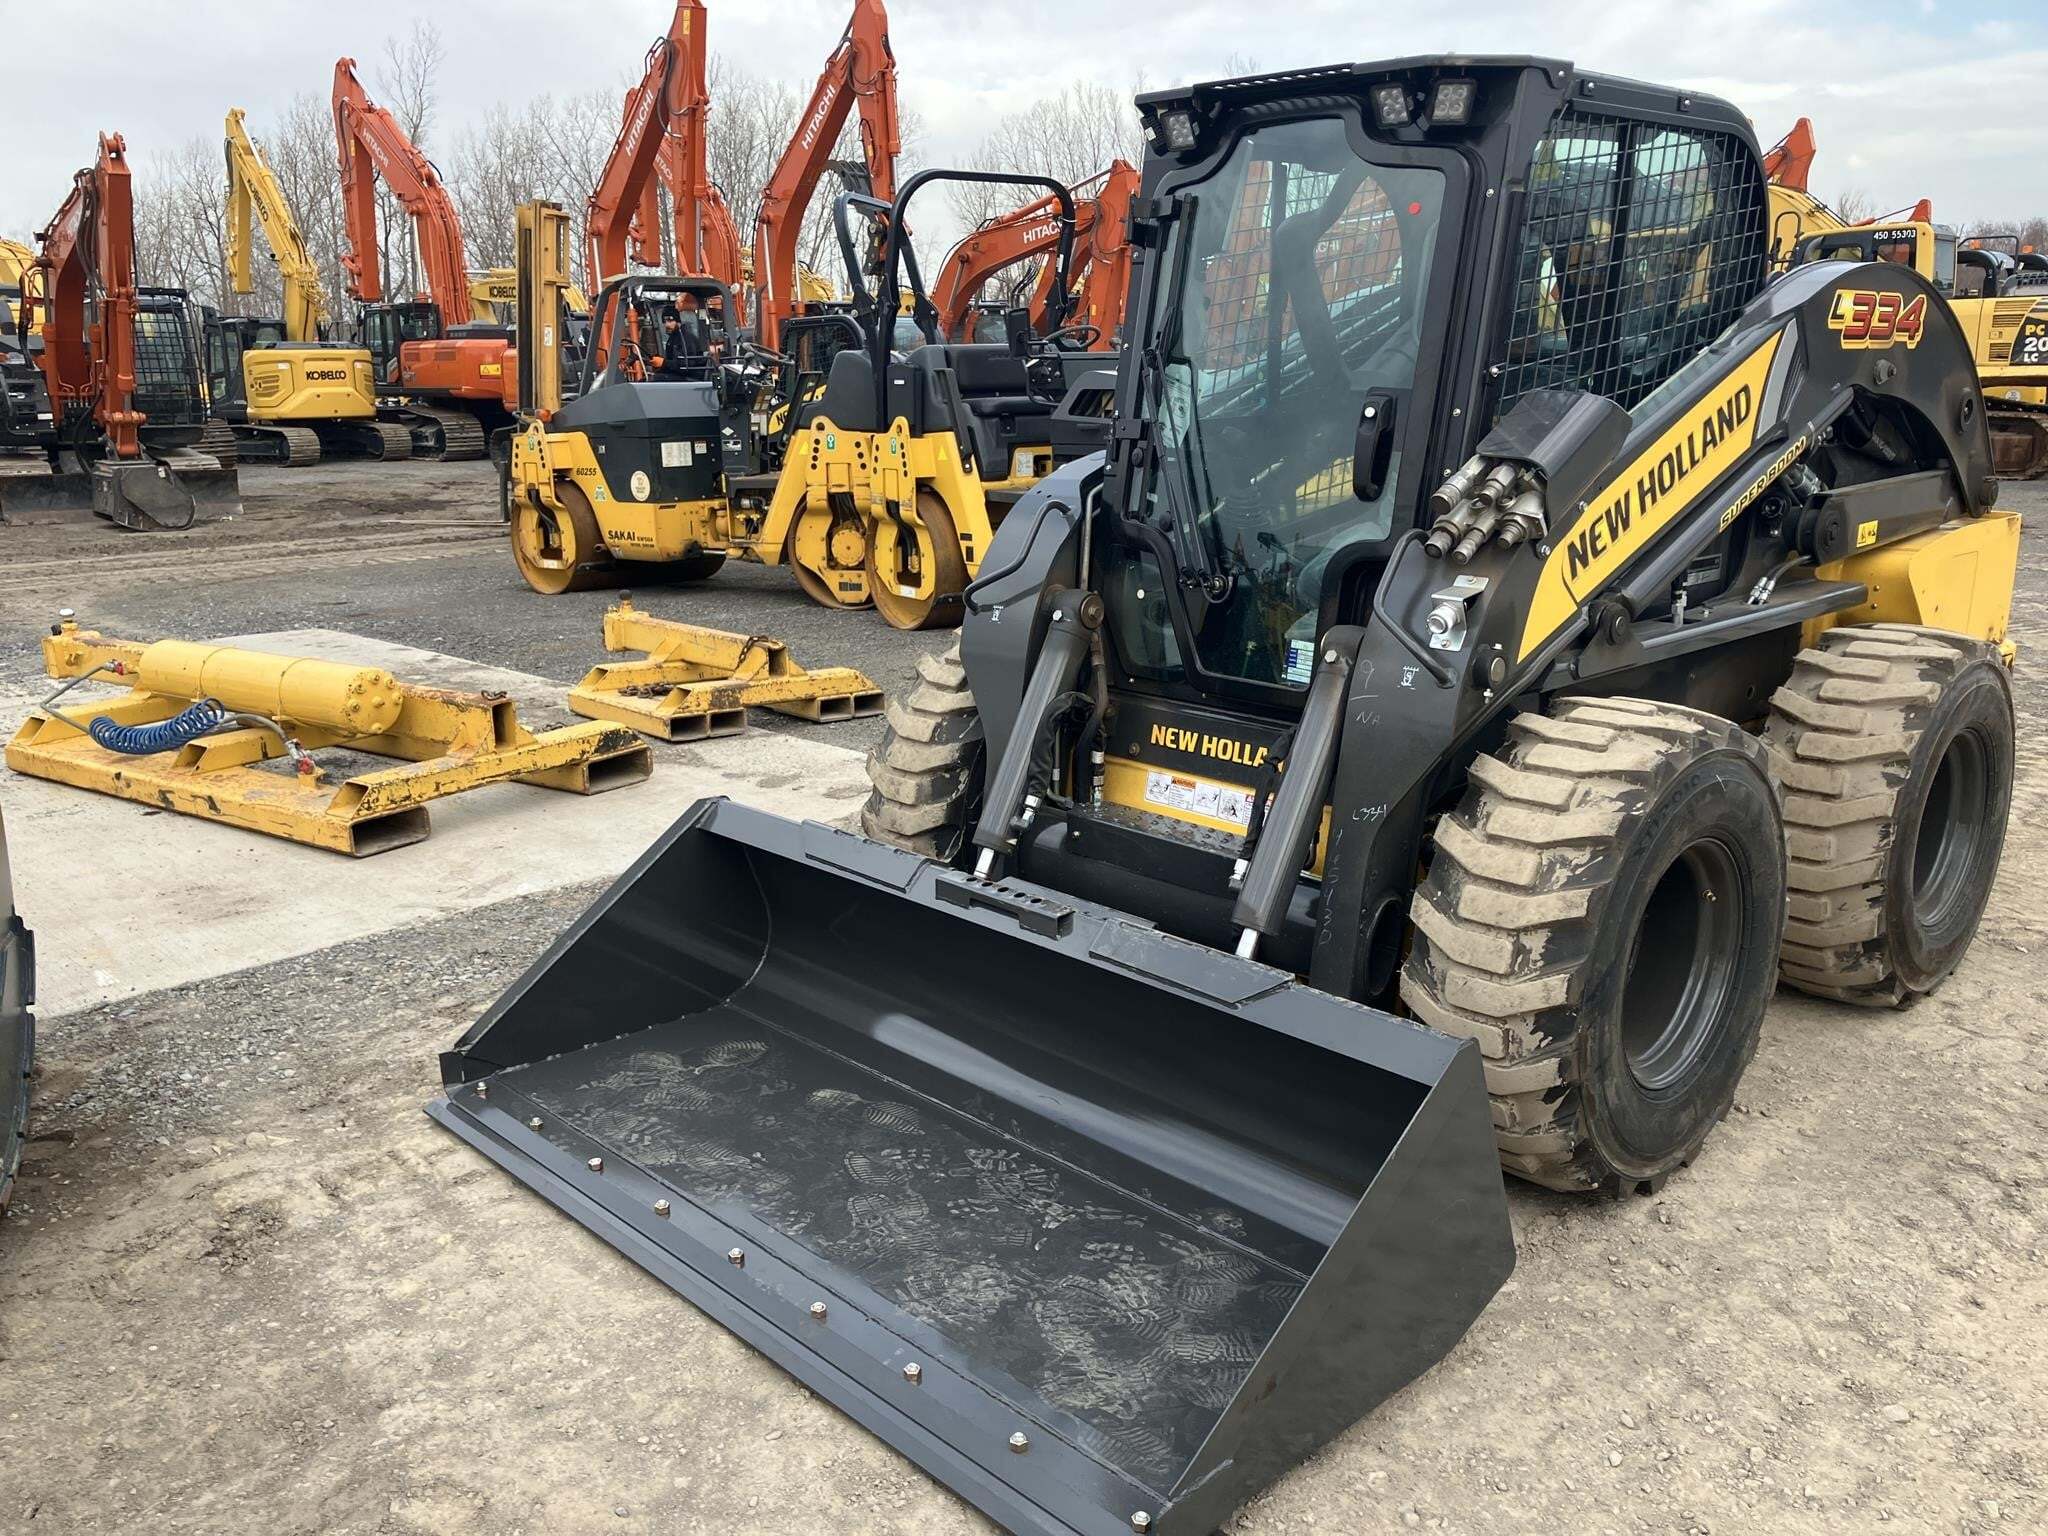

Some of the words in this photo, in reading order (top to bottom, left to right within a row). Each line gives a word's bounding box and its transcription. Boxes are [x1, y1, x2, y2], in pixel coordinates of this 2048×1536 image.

[626, 89, 654, 156] HITACHI
[801, 84, 835, 150] HITACHI
[364, 128, 389, 168] HITACHI
[247, 179, 268, 222] KOBELCO
[1023, 221, 1062, 244] HITAC
[1873, 231, 1889, 240] 450
[488, 285, 517, 298] KOBELC
[1828, 289, 1927, 349] L334
[2025, 324, 2046, 336] PC
[2023, 352, 2039, 363] LC
[306, 370, 347, 380] KOBELCO
[576, 467, 597, 477] 60255
[1567, 487, 1631, 582] NEW
[1637, 383, 1752, 518] HOLLAND
[1719, 474, 1767, 533] SUPER
[1767, 435, 1806, 483] BOOM
[607, 530, 636, 542] SAKAI
[1150, 723, 1199, 754] NEW
[1201, 734, 1284, 773] HOLLA
